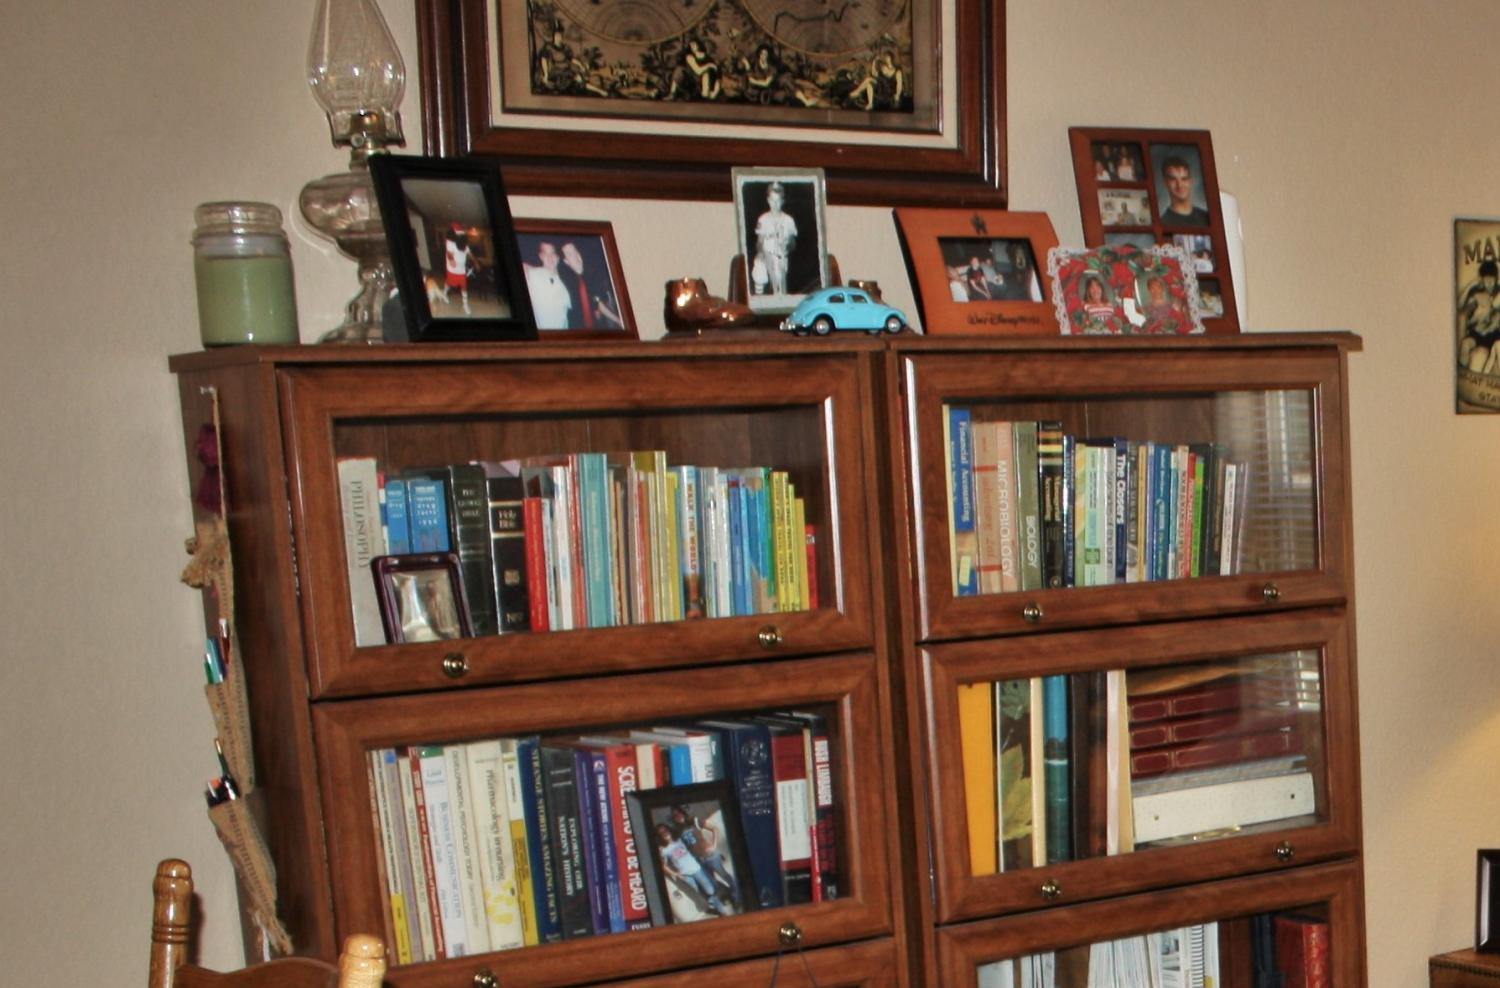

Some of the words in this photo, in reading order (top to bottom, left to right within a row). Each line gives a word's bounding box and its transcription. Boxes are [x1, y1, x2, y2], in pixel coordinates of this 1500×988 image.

[961, 421, 969, 465] Financial
[1117, 454, 1126, 477] The
[961, 468, 971, 522] Accounting
[1045, 476, 1053, 521] Accounting
[1053, 475, 1062, 522] Managerial
[1117, 480, 1126, 524] Closers
[350, 480, 370, 569] PHILOSOPHY
[998, 460, 1013, 577] MICROBIOLOGY
[1026, 515, 1037, 568] BIOLOGY
[452, 750, 465, 809] DEVELOPMENTAL
[531, 749, 543, 795] STRANGE
[440, 801, 453, 840] BUSINESS
[536, 798, 548, 841] STORIES
[617, 766, 636, 834] SCREING
[458, 811, 470, 857] PSYCHOLOGY
[485, 769, 503, 835] Pharmacology
[494, 846, 507, 881] nursing
[558, 815, 570, 856] NATION'S
[421, 834, 432, 879] Fundamentals
[463, 858, 474, 880] TODAY
[542, 844, 553, 891] AMAZING
[568, 817, 581, 867] EXPLORING
[575, 870, 583, 890] OUR
[626, 856, 639, 870] BE
[446, 843, 462, 919] COMMUNICATION
[561, 859, 574, 896] HISTORY
[628, 872, 647, 911] HEARD
[429, 887, 438, 914] Financial
[548, 893, 558, 923] FACTS
[433, 915, 443, 952] Accounting
